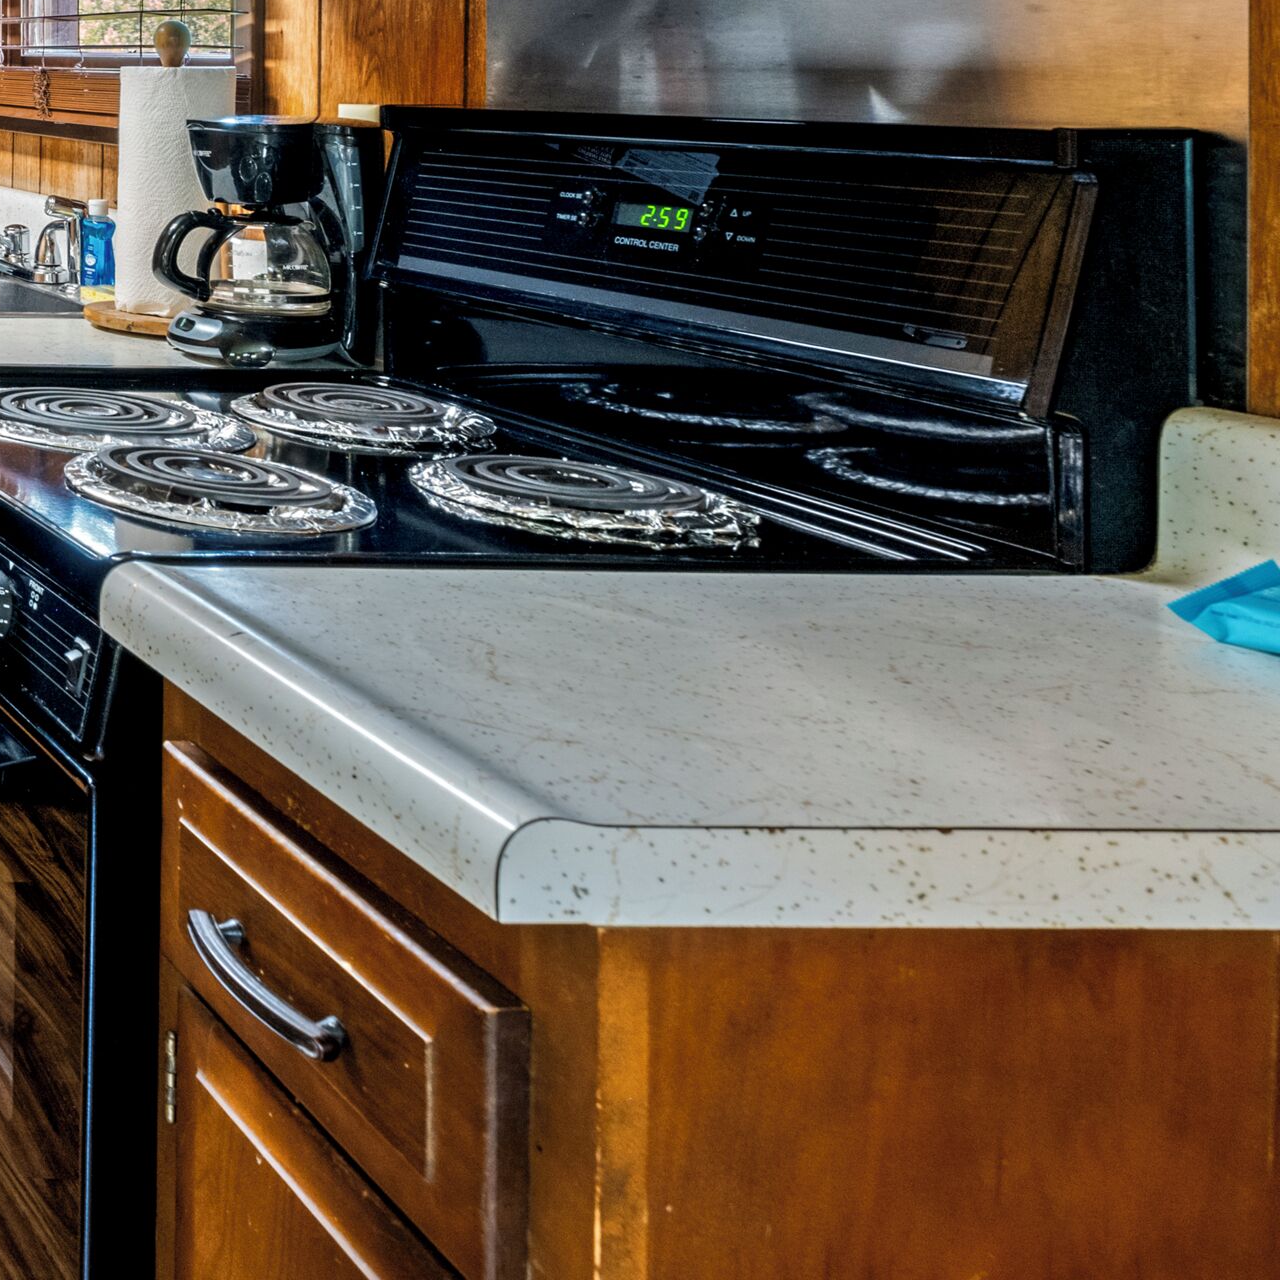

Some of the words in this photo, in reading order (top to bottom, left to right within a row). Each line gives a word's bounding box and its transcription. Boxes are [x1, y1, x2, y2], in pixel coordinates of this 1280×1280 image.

[614, 236, 648, 248] CONTROL
[648, 240, 680, 252] CENTER
[736, 235, 756, 243] DOWN
[28, 580, 45, 595] FRONT
